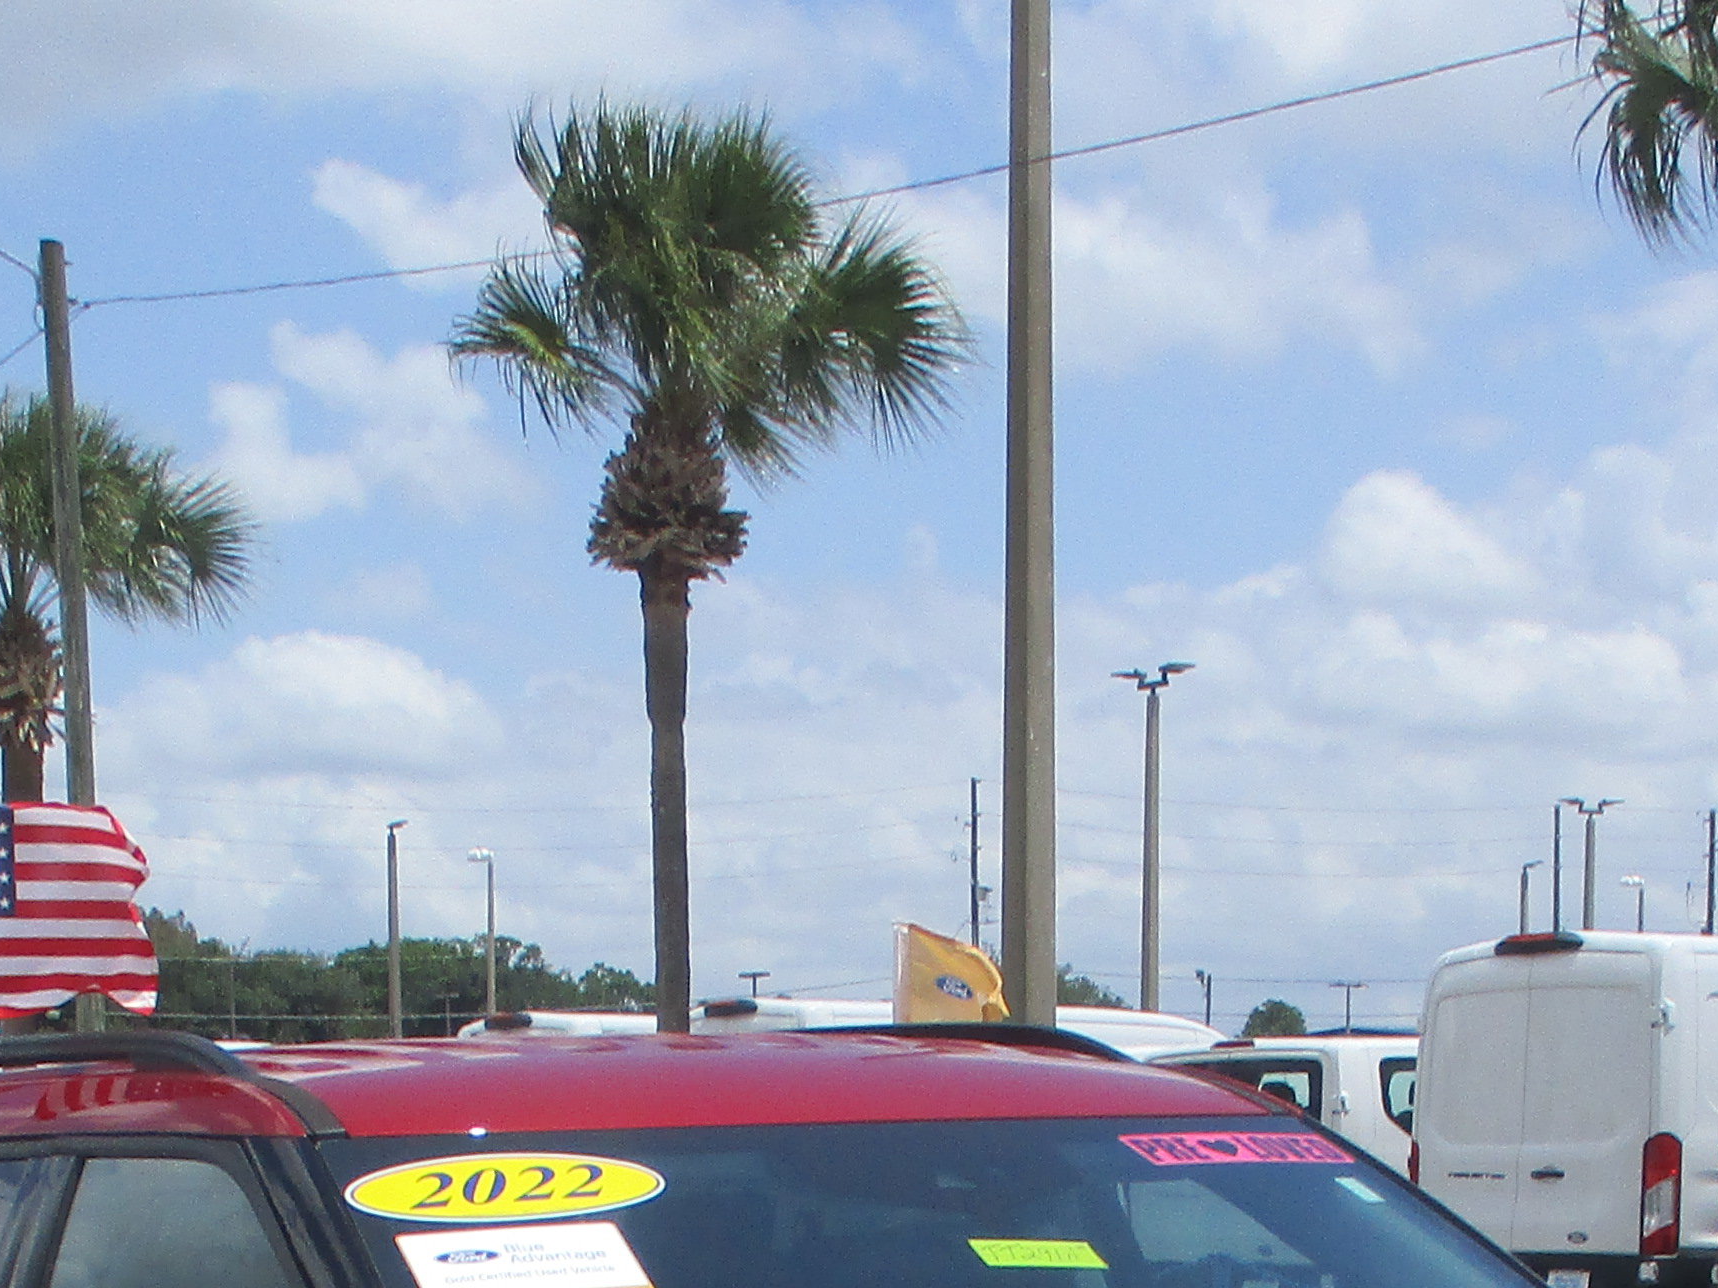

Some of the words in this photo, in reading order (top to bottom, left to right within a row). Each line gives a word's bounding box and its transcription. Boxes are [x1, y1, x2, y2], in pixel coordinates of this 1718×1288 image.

[1129, 1136, 1210, 1161] PRE
[1233, 1135, 1347, 1161] LOVED
[410, 1163, 604, 1210] 2022
[503, 1242, 545, 1254] Blue
[511, 1249, 607, 1265] Advantage
[478, 1268, 532, 1282] Certified
